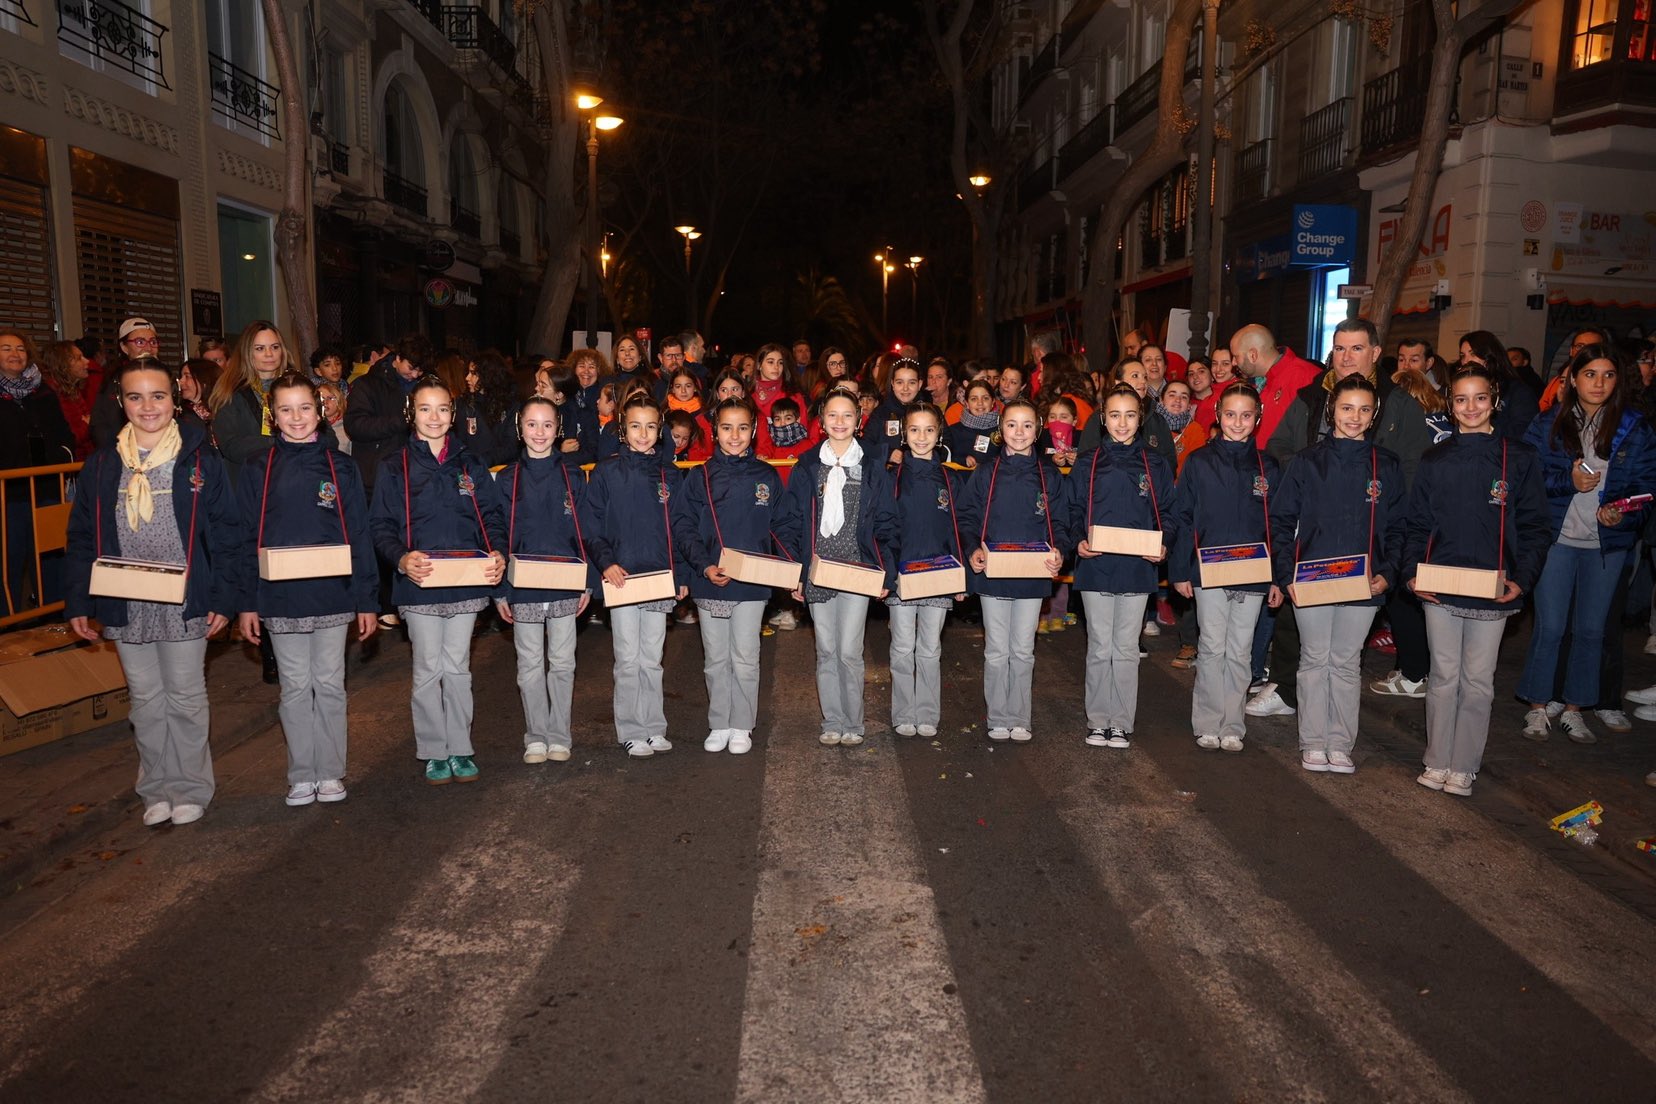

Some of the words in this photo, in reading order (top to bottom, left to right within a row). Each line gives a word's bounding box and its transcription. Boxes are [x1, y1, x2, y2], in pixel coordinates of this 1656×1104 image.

[1590, 212, 1621, 233] BAR
[1297, 231, 1345, 246] Change
[1296, 244, 1335, 258] Group
[1258, 250, 1291, 272] Chang
